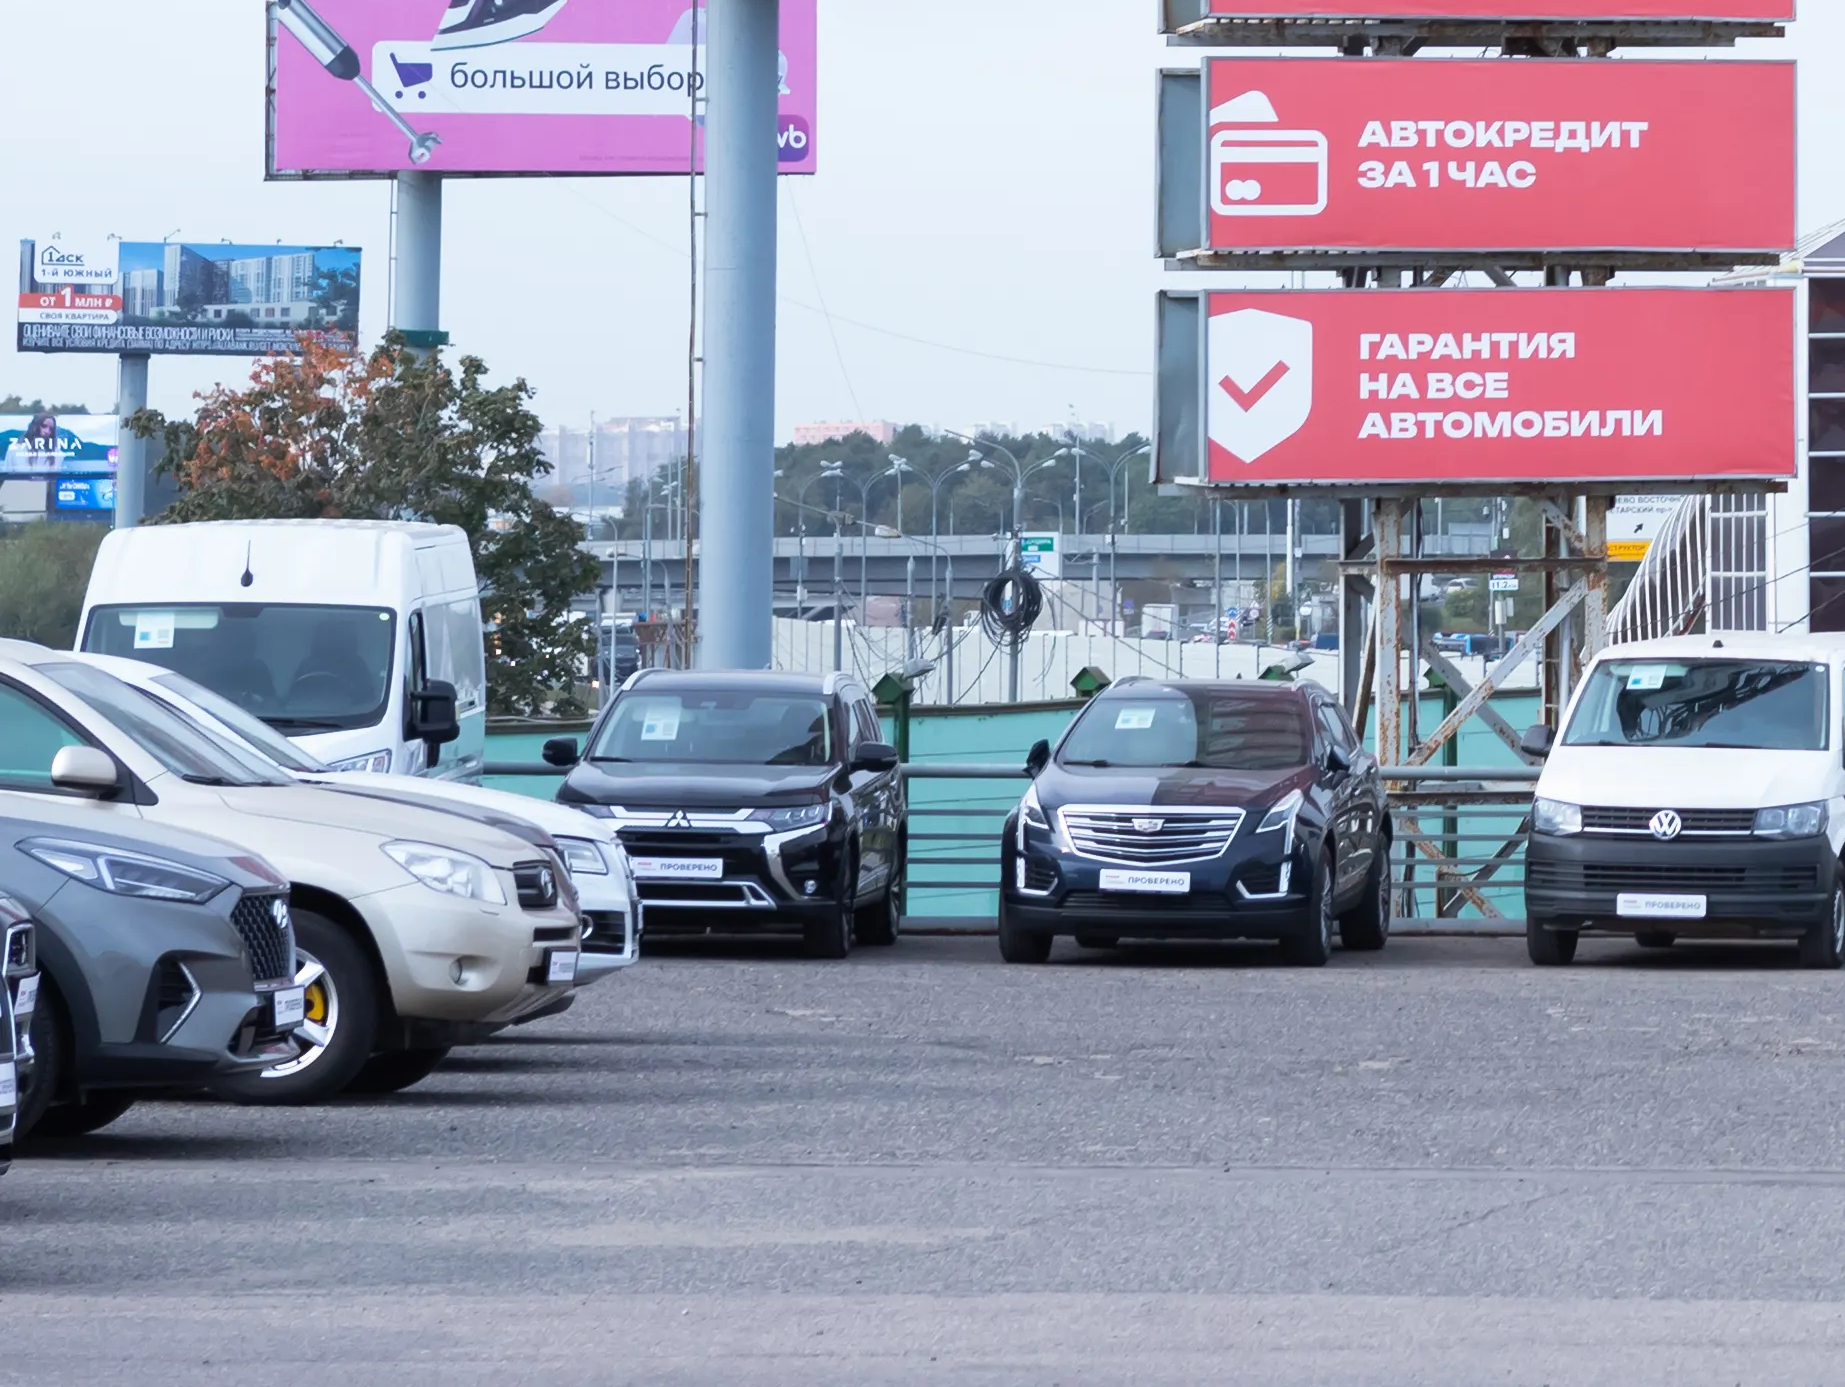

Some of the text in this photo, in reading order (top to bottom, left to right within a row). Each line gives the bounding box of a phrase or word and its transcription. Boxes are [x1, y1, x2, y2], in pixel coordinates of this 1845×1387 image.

[450, 62, 704, 98] большой выбор
[1357, 120, 1649, 152] АВТОКРЕДИТ
[1357, 160, 1537, 188] ЗА 1 ЧАС
[63, 268, 112, 277] ЮЖНЫЙ
[61, 287, 71, 307] 1
[65, 313, 110, 321] КВАРТИРА
[1359, 332, 1575, 360] ГАРАНТИЯ
[1359, 371, 1509, 400] НА ВСЕ
[1357, 410, 1663, 439] АВТОМОБИЛИ
[9, 437, 82, 449] ZARINA
[660, 863, 718, 872] ПРОВЕРЕНО
[1128, 876, 1185, 886] ПРОВЕРЕНО
[1645, 900, 1702, 910] ПРОВЕРЕНО
